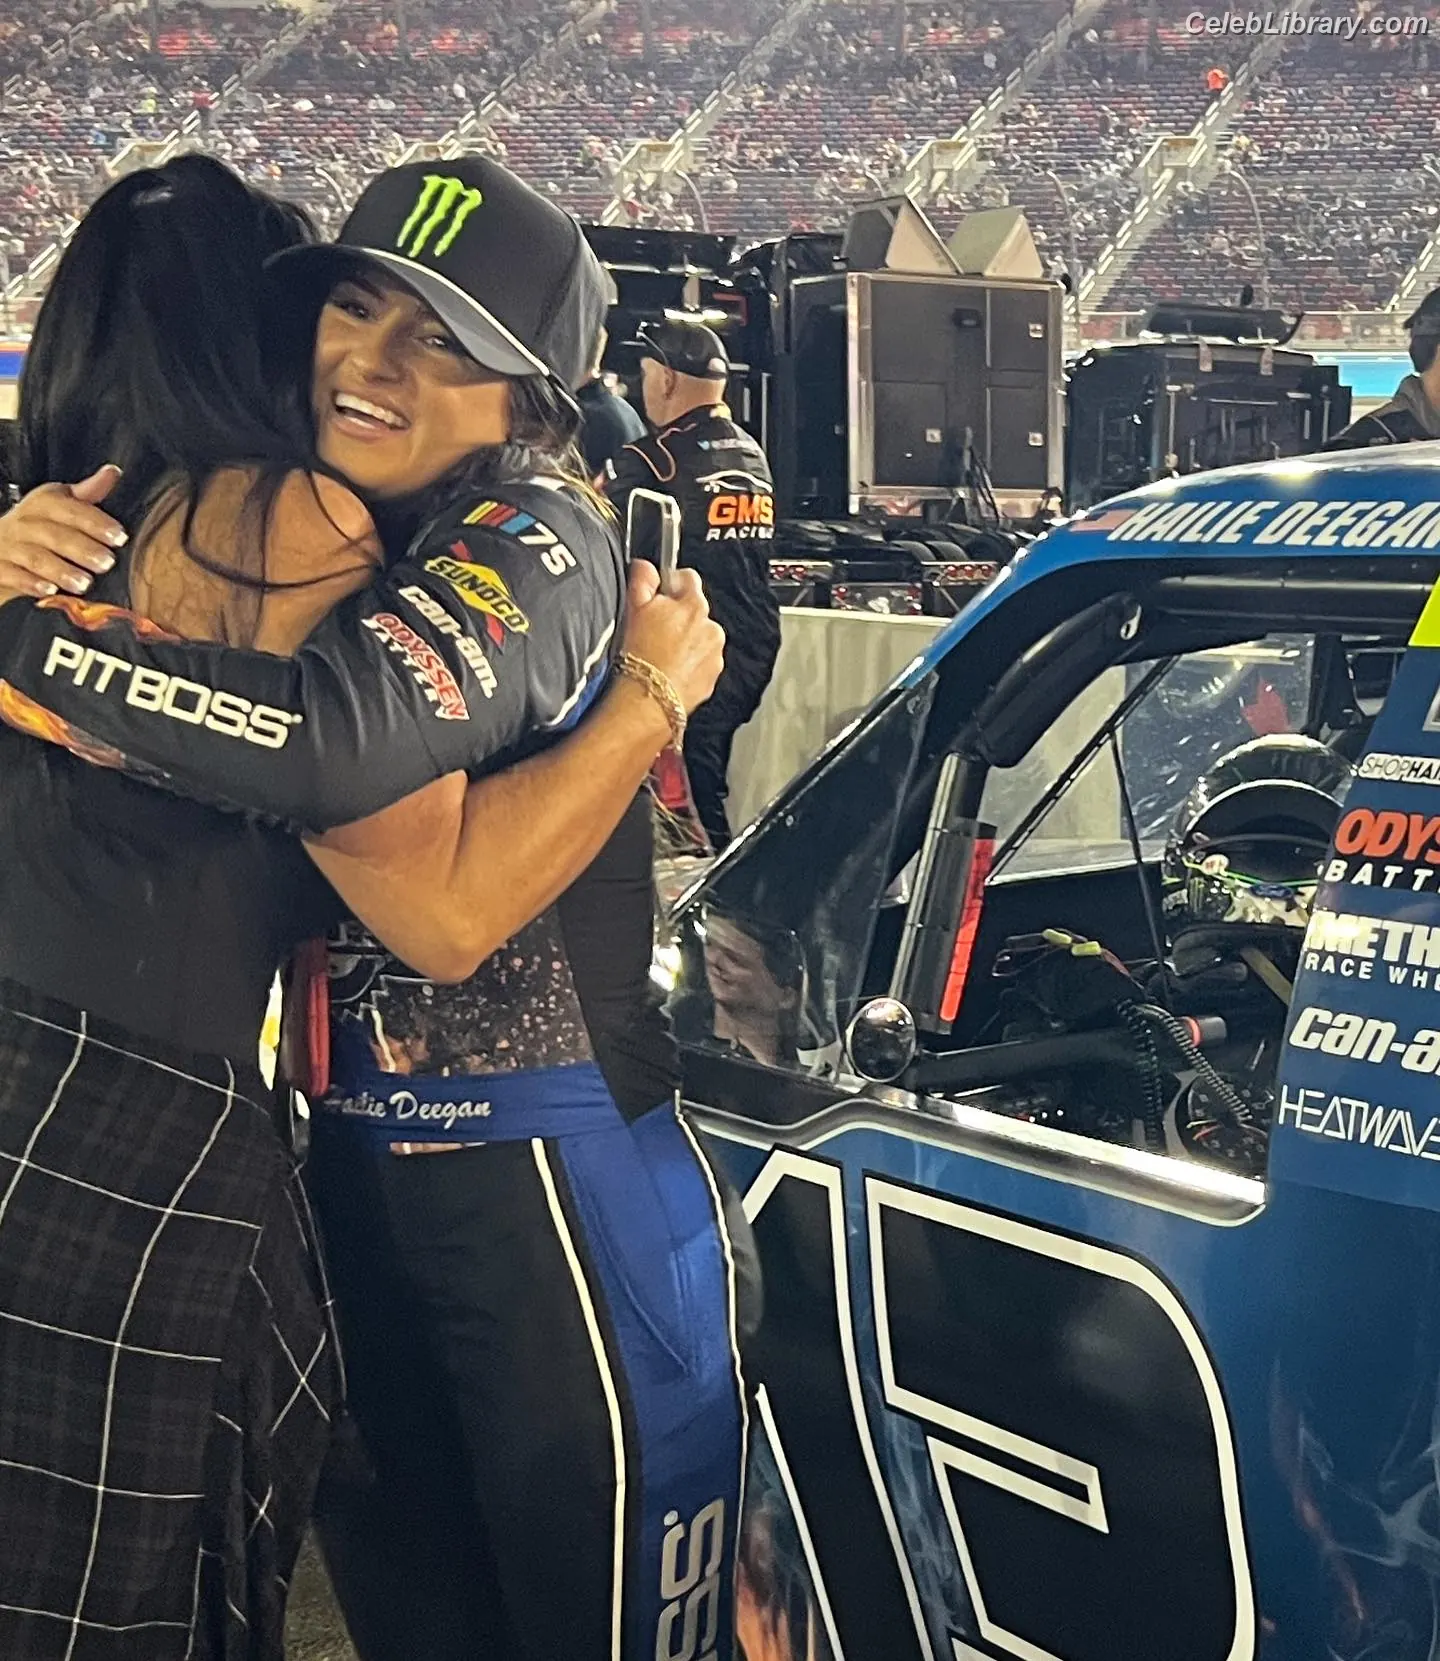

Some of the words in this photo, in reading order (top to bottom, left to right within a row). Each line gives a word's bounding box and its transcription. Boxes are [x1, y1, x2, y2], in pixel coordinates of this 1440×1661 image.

[708, 494, 774, 526] GMS
[1107, 501, 1280, 543] HAILIE
[518, 522, 577, 577] 75
[429, 560, 526, 627] SUNOCO
[1360, 757, 1440, 781] SHOPHAI
[1324, 858, 1440, 894] BATT
[1304, 952, 1374, 980] RACE
[389, 1090, 492, 1130] Deegan
